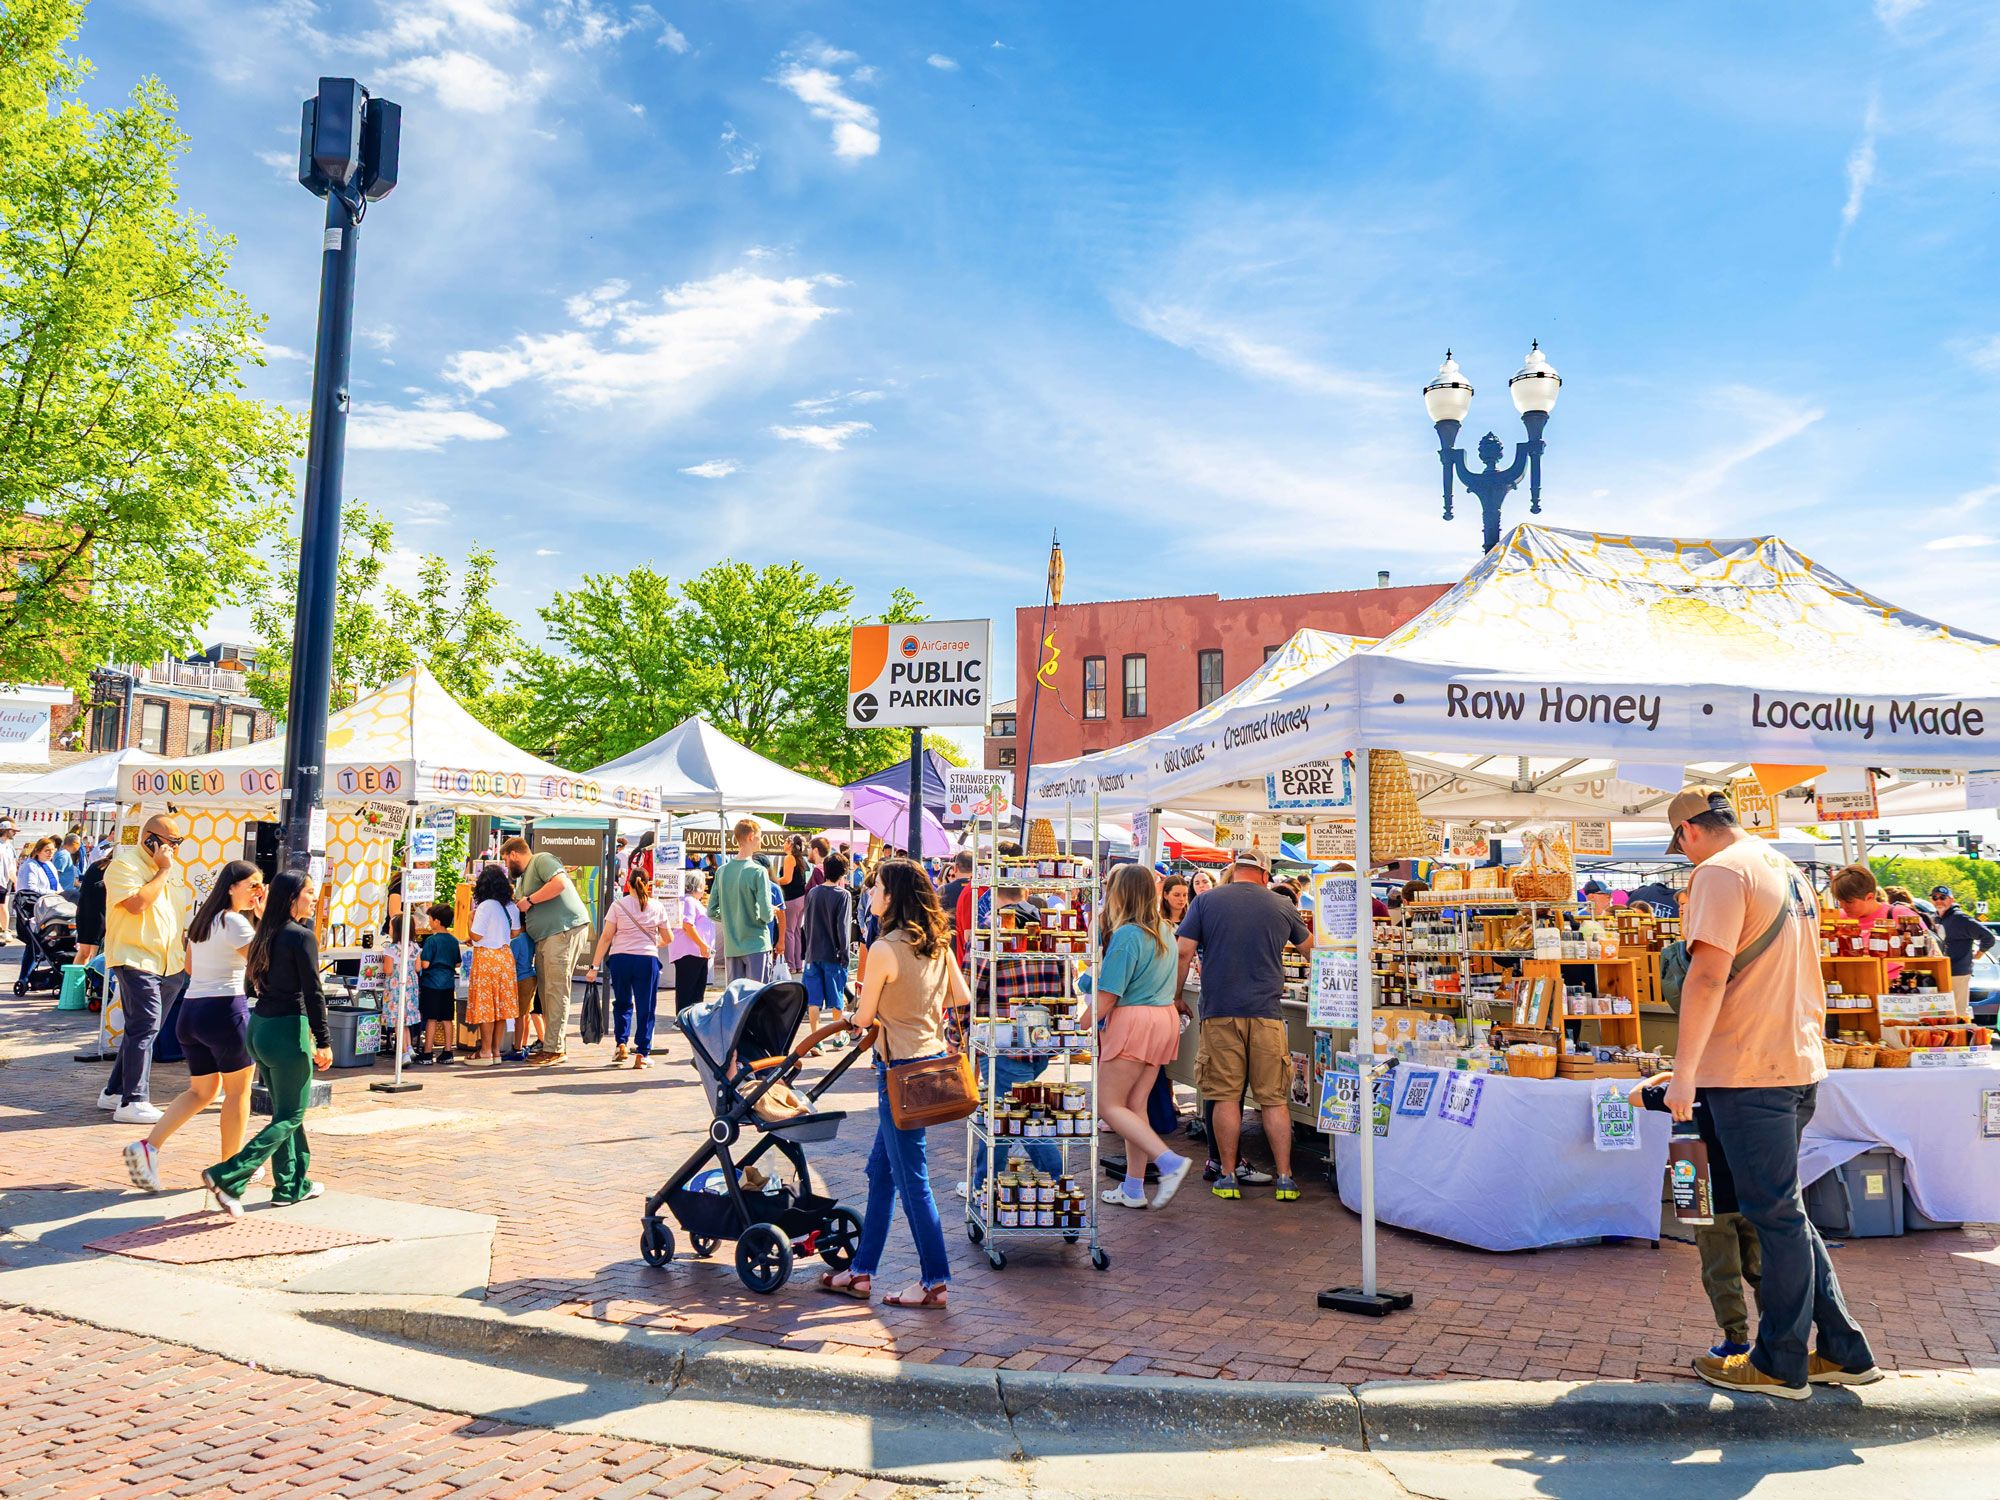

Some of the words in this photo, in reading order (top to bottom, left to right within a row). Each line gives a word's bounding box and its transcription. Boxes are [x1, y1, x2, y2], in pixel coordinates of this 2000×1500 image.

[920, 640, 970, 652] AirGarage
[890, 660, 982, 684] PUBLIC
[889, 688, 981, 708] PARKING
[1447, 683, 1525, 720] Raw
[1539, 686, 1661, 731] Honey
[1752, 692, 1875, 739] Locally
[1889, 700, 1985, 735] Made
[1223, 712, 1268, 750] Creamed
[1270, 703, 1311, 737] Honey
[1163, 748, 1180, 773] BBQ
[1180, 742, 1206, 768] Sauce
[342, 770, 397, 790] TEA
[950, 773, 1007, 785] STRAWBERRY
[1281, 768, 1334, 782] BODY
[136, 773, 219, 792] HONEY
[950, 784, 990, 794] RHUBARB
[1283, 781, 1334, 795] CARE
[438, 772, 521, 794] HONEY
[545, 780, 597, 801] ICED
[616, 790, 650, 809] TEA
[950, 794, 969, 804] JAM
[369, 801, 406, 815] STRAWBERRY
[380, 820, 395, 831] GREEN
[388, 813, 404, 824] BASIL
[541, 836, 573, 845] Downtown
[573, 836, 596, 846] Omaha
[1322, 968, 1335, 976] BEE
[1322, 977, 1358, 992] SALVE
[1338, 1077, 1381, 1094] BUZ
[1409, 1087, 1428, 1097] BODY
[1406, 1096, 1425, 1107] CARE
[1607, 1104, 1623, 1112] DILL
[1603, 1111, 1628, 1119] PICKLE
[1600, 1123, 1611, 1133] LIP
[1613, 1122, 1633, 1133] BALM
